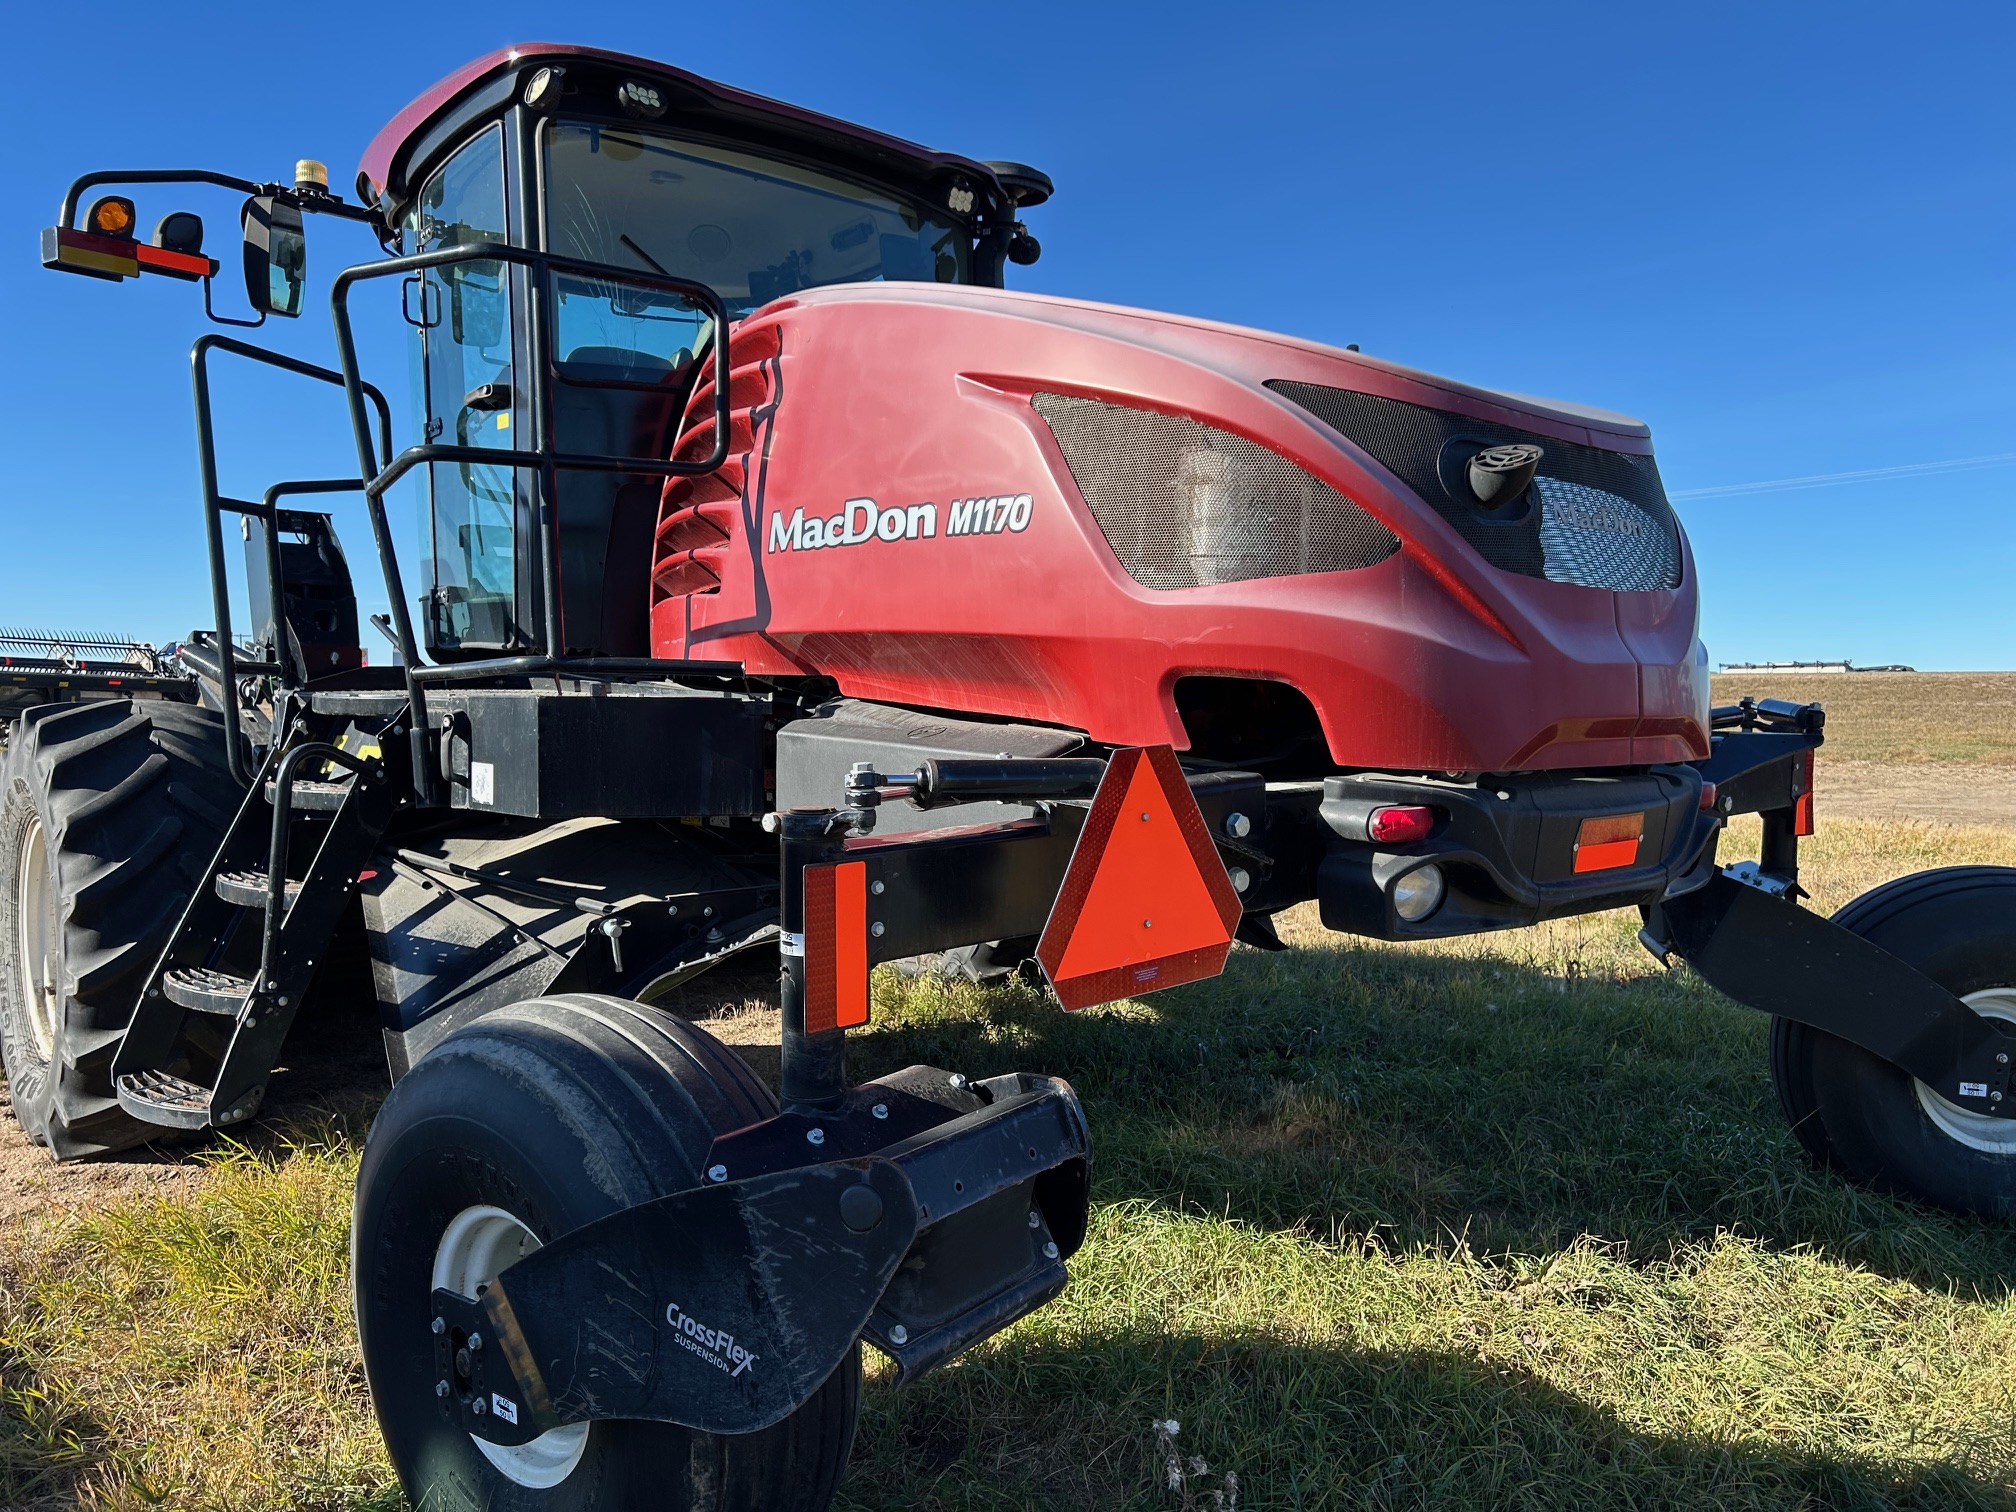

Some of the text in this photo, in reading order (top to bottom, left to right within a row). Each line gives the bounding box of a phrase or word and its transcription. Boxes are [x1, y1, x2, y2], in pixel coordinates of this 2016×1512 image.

[768, 493, 1033, 554] MacDon M1170
[1551, 500, 1644, 537] MacDon
[666, 1302, 755, 1378] CrossFlex
[673, 1332, 730, 1373] SUSPENSION
